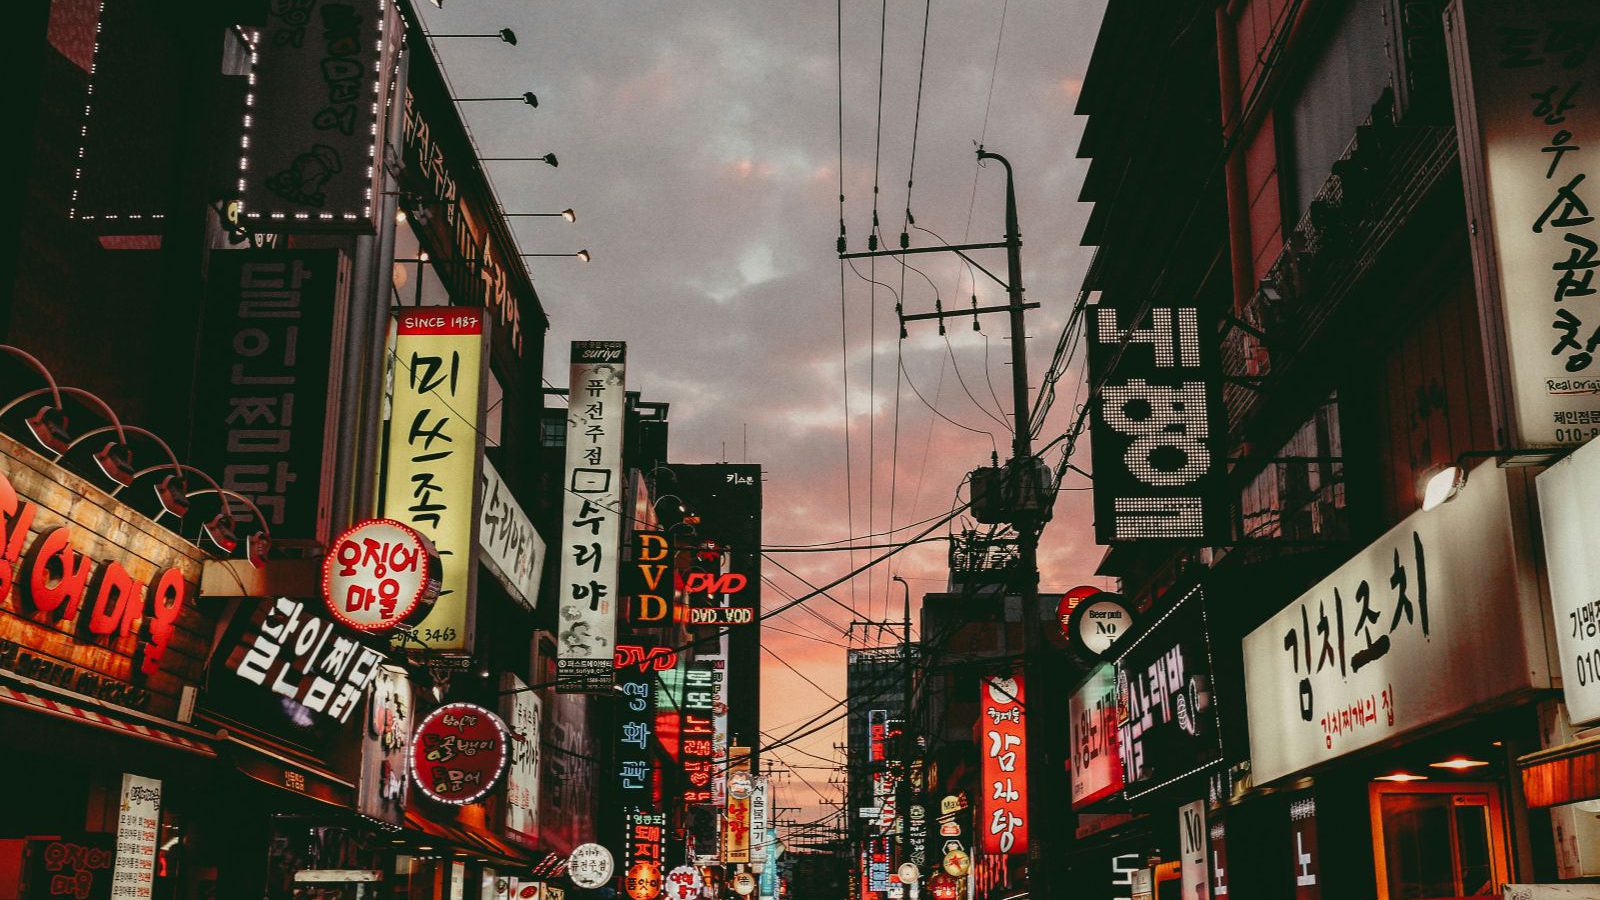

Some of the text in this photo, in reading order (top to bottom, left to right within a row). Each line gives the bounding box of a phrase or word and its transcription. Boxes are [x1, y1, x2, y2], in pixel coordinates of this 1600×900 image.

[404, 316, 479, 328] SINCE 1987
[582, 347, 622, 362] suriya
[222, 260, 312, 526] 달인찜닭
[1548, 379, 1571, 391] Real
[584, 379, 606, 466] 퓨전주점
[337, 537, 419, 579] 오징어
[572, 500, 608, 611] 수리야
[638, 534, 668, 621] DVD
[684, 572, 748, 594] DVD
[346, 578, 400, 620] 마을
[1089, 610, 1106, 619] Beer
[425, 626, 457, 642] 3463
[1284, 530, 1430, 722] 김치조치
[614, 645, 678, 672] DVD
[1382, 684, 1395, 727] 집
[619, 682, 651, 789] 영화관
[987, 731, 1023, 853] 감자탕
